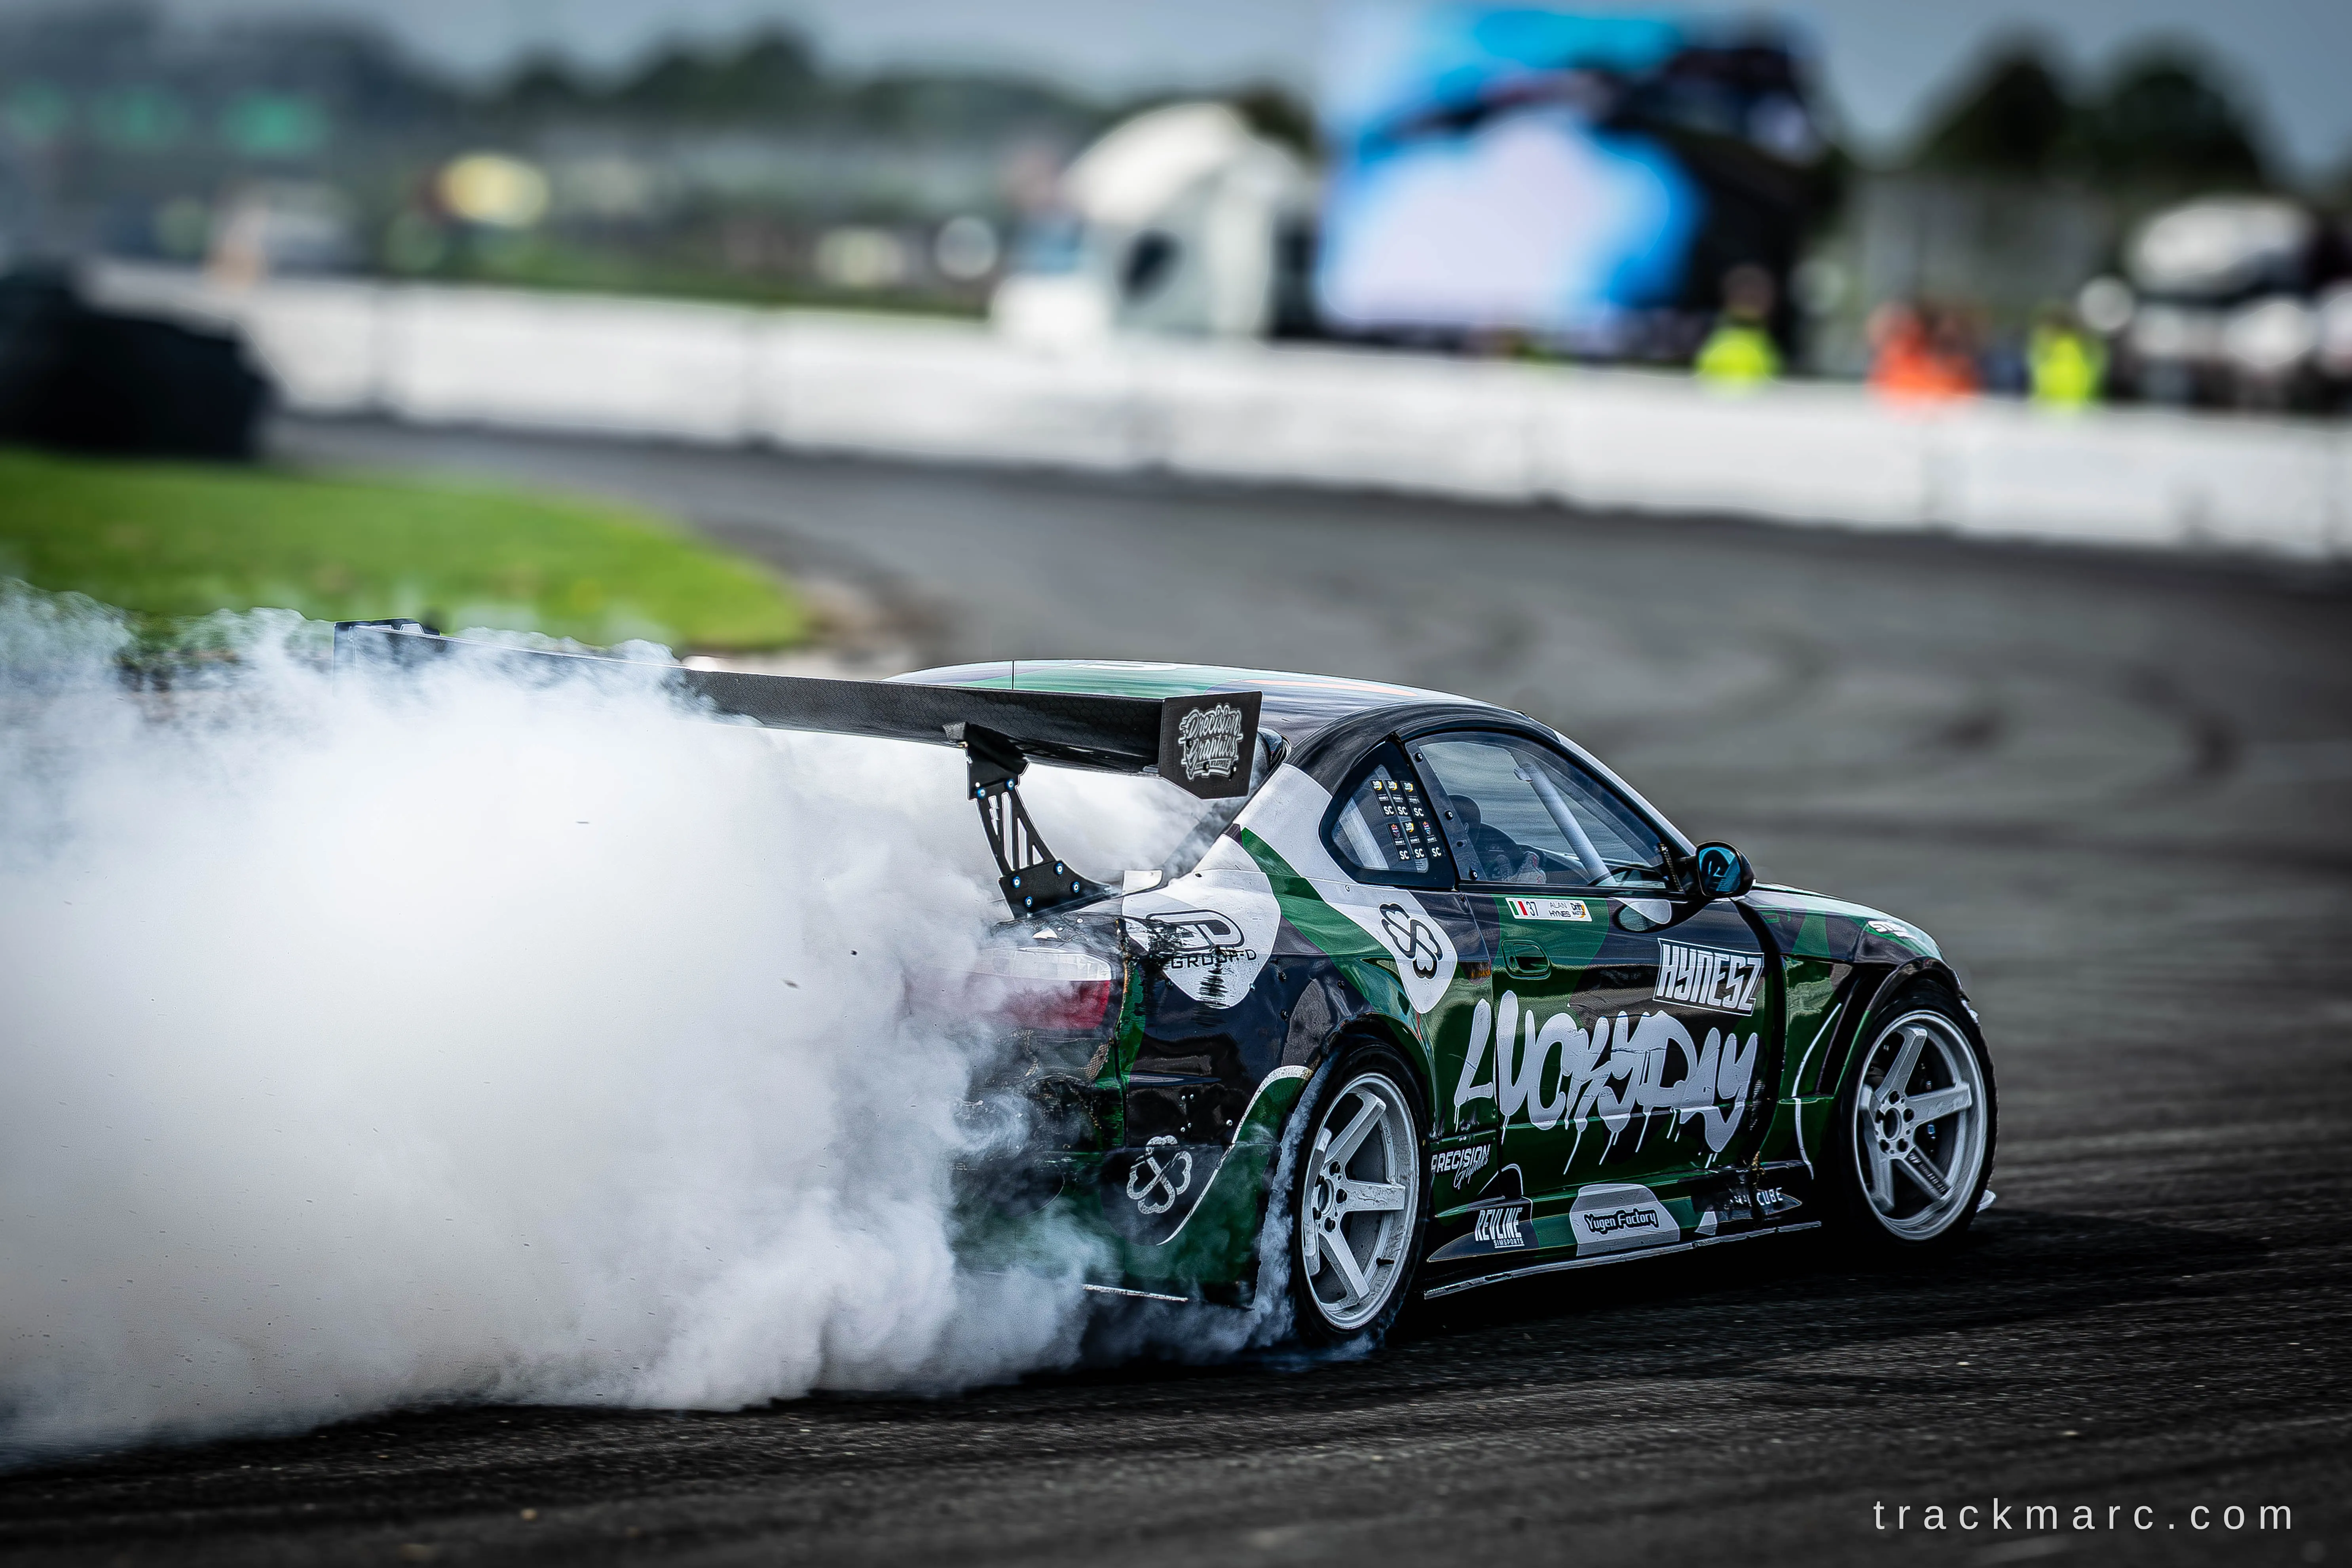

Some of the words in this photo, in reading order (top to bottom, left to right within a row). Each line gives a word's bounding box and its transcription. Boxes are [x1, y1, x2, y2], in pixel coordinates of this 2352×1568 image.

[1384, 805, 1394, 815] SC
[1397, 806, 1408, 815] SC
[1414, 807, 1424, 816] SC
[1399, 850, 1409, 860] SC
[1414, 848, 1424, 858] SC
[1431, 847, 1441, 857] SC
[1526, 901, 1539, 916] 37
[1570, 902, 1582, 911] Drift
[1431, 1144, 1491, 1174] PRECISION
[1454, 1152, 1490, 1190] Graphics
[1475, 1207, 1523, 1241] REVLINE
[1586, 1217, 1616, 1231] Yugen
[1617, 1211, 1657, 1226] Factory
[1493, 1238, 1524, 1246] SIMSPORTS
